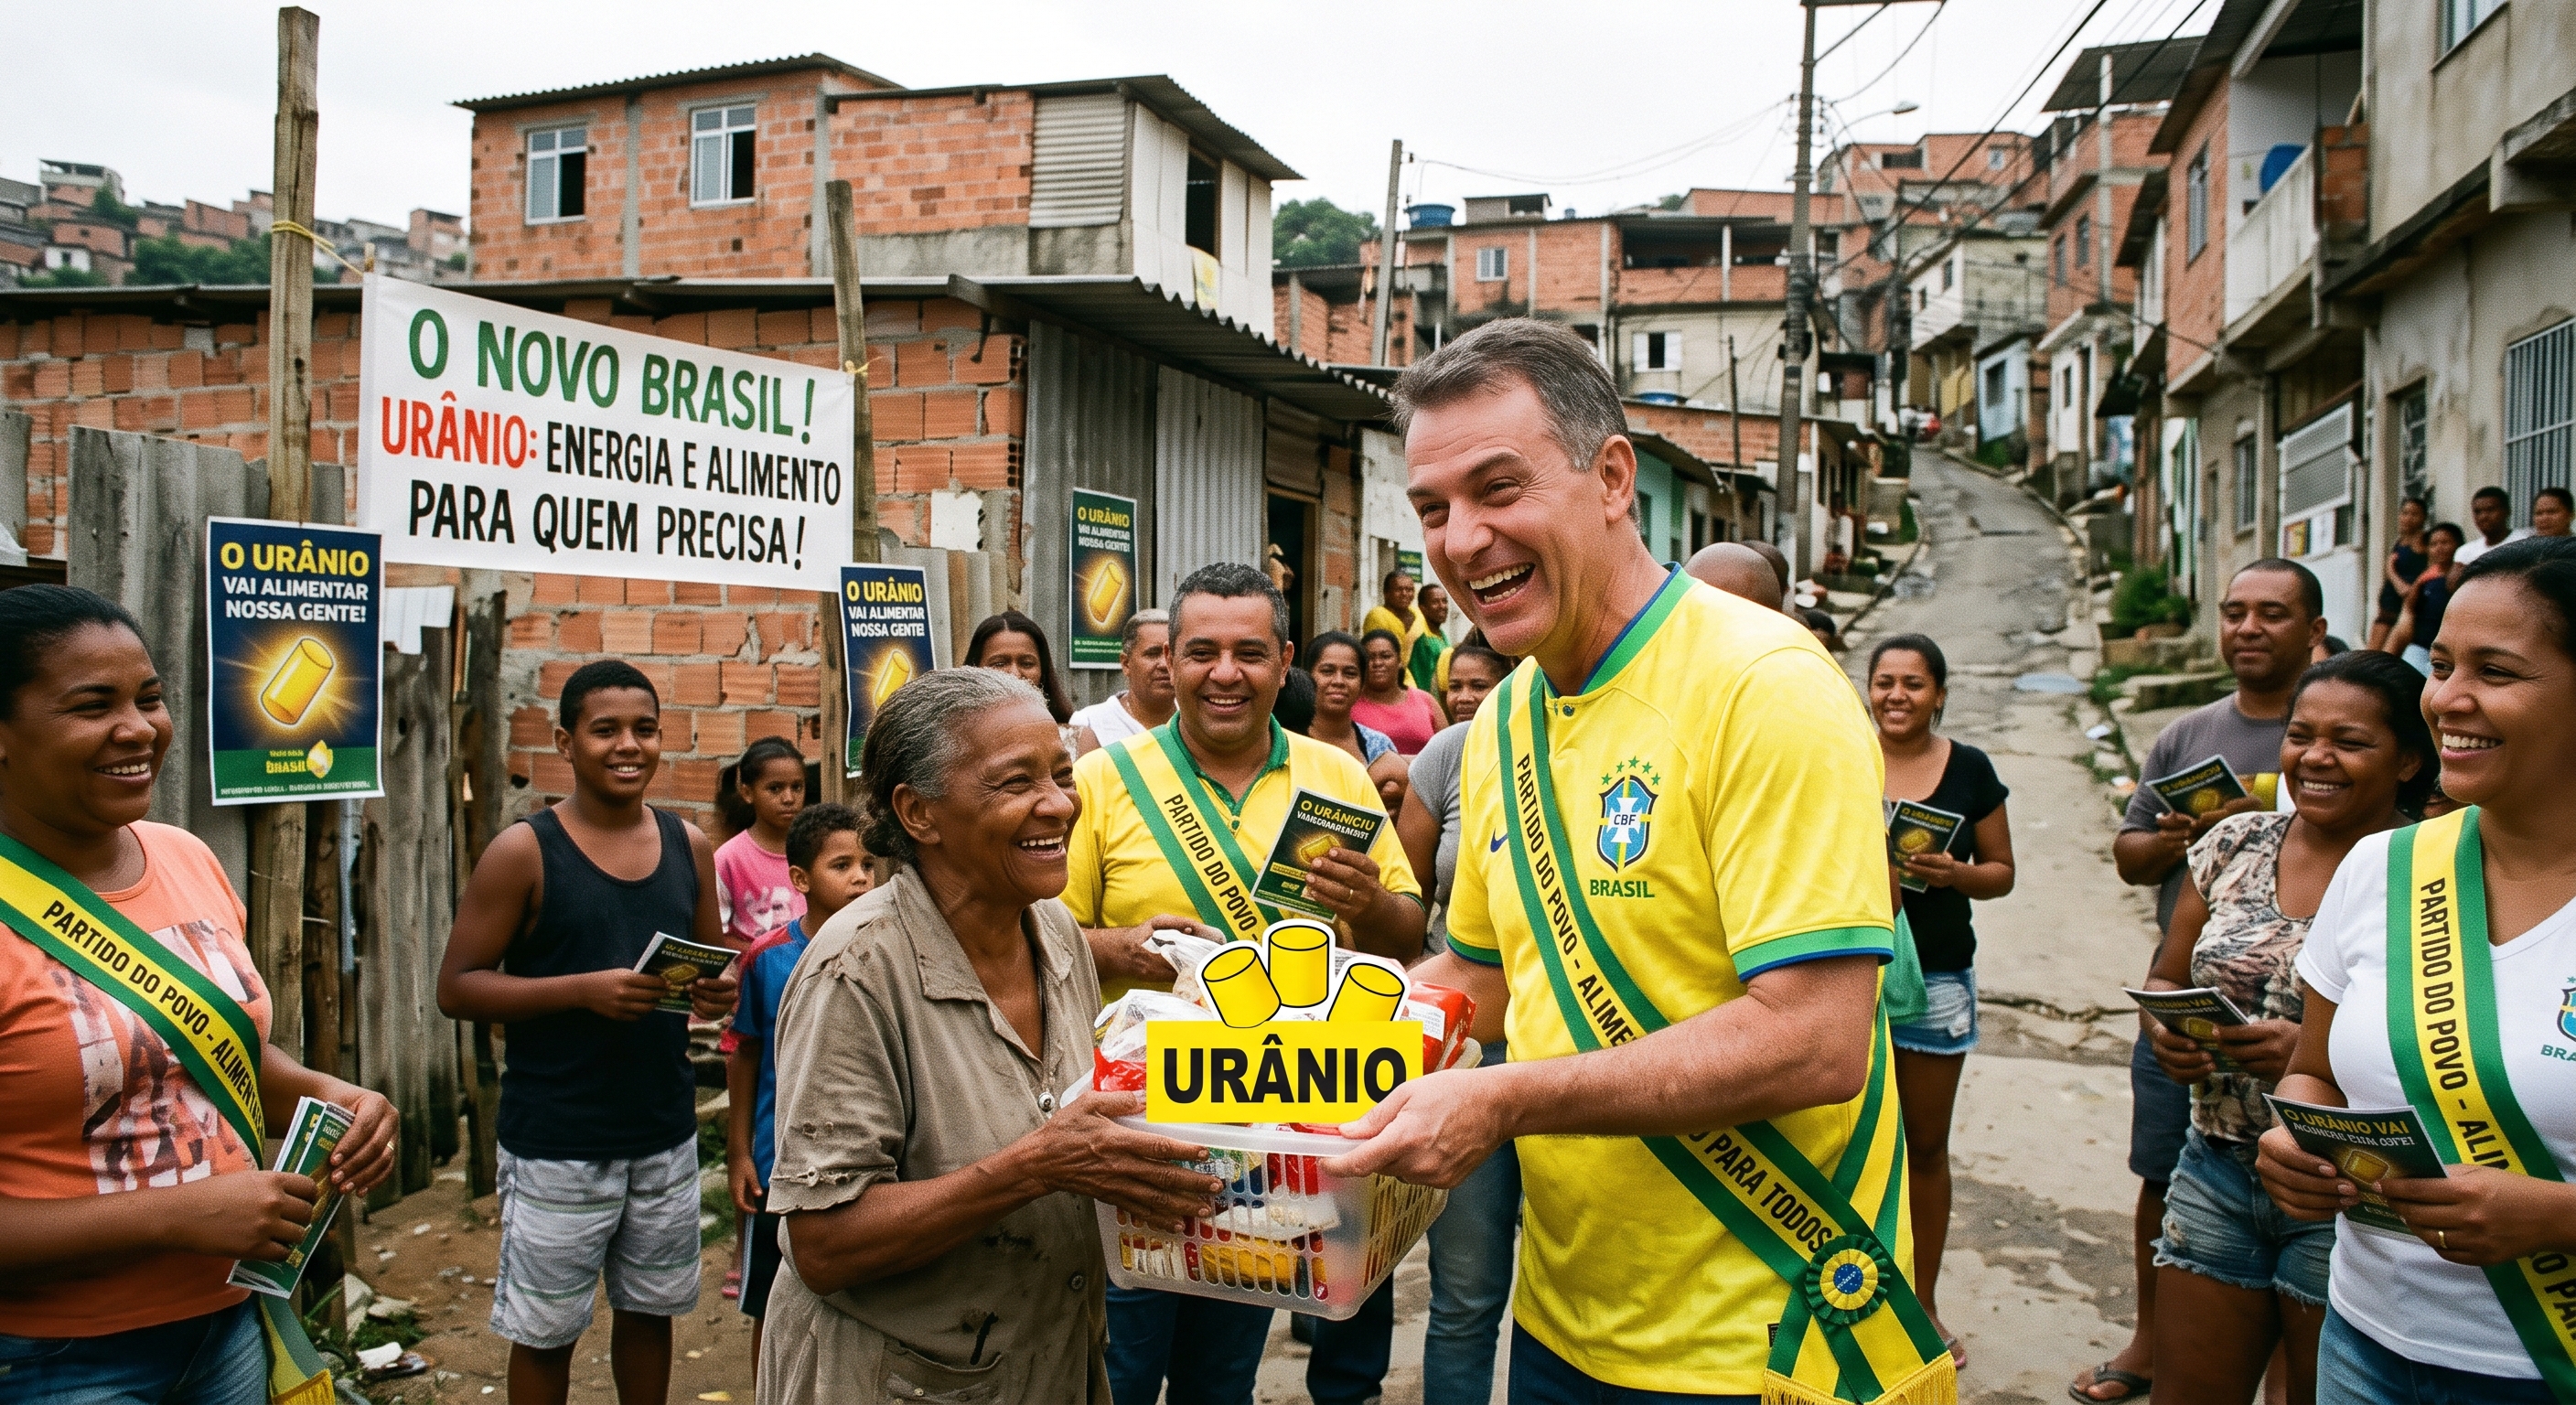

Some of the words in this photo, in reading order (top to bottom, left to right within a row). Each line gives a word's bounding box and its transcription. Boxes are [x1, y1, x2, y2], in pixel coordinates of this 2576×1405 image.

[409, 308, 448, 380] O
[478, 320, 619, 408] NOVO
[382, 391, 537, 468] URÂNIO:
[547, 421, 673, 487] ENERGIA
[684, 441, 697, 488] E
[706, 445, 841, 506] ALIMENTO
[409, 479, 515, 543] PARA
[533, 493, 638, 553] QUEM
[657, 506, 806, 570] PRECISA!
[1078, 506, 1087, 520] O
[220, 542, 245, 570] O
[252, 540, 370, 577] URÂNIO
[222, 576, 256, 595] VAI
[261, 578, 369, 600] ALIMENTAR
[846, 580, 860, 602] O
[863, 576, 923, 603] URÂNIO
[225, 599, 295, 620] NOSSA
[299, 603, 367, 623] GENTE!
[848, 606, 867, 619] VAI
[869, 606, 925, 619] ALIMENTAR
[851, 623, 889, 637] NOSSA
[1301, 799, 1313, 811] O
[1614, 814, 1637, 826] CBF
[1164, 793, 1215, 862] PARTIDO
[1204, 861, 1230, 886] DO
[1218, 885, 1258, 931] POVO
[1517, 754, 1544, 853] PARTIDO
[1535, 851, 1555, 890] DO
[1547, 886, 1578, 955] POVO
[1577, 974, 1637, 1047] ALIME
[1590, 879, 1655, 898] BRASIL
[2420, 877, 2453, 977] PARTIDO
[42, 899, 130, 972] PARTIDO
[128, 963, 161, 993] DO
[159, 985, 209, 1035] POVO
[2424, 981, 2455, 1015] DO
[1164, 1034, 1407, 1104] URÂNIO
[2427, 1018, 2468, 1091] POVO
[2283, 1109, 2300, 1121] O
[2373, 1121, 2410, 1135] VAI
[1703, 1132, 1768, 1196] PARA
[1760, 1181, 1832, 1253] TODOS
